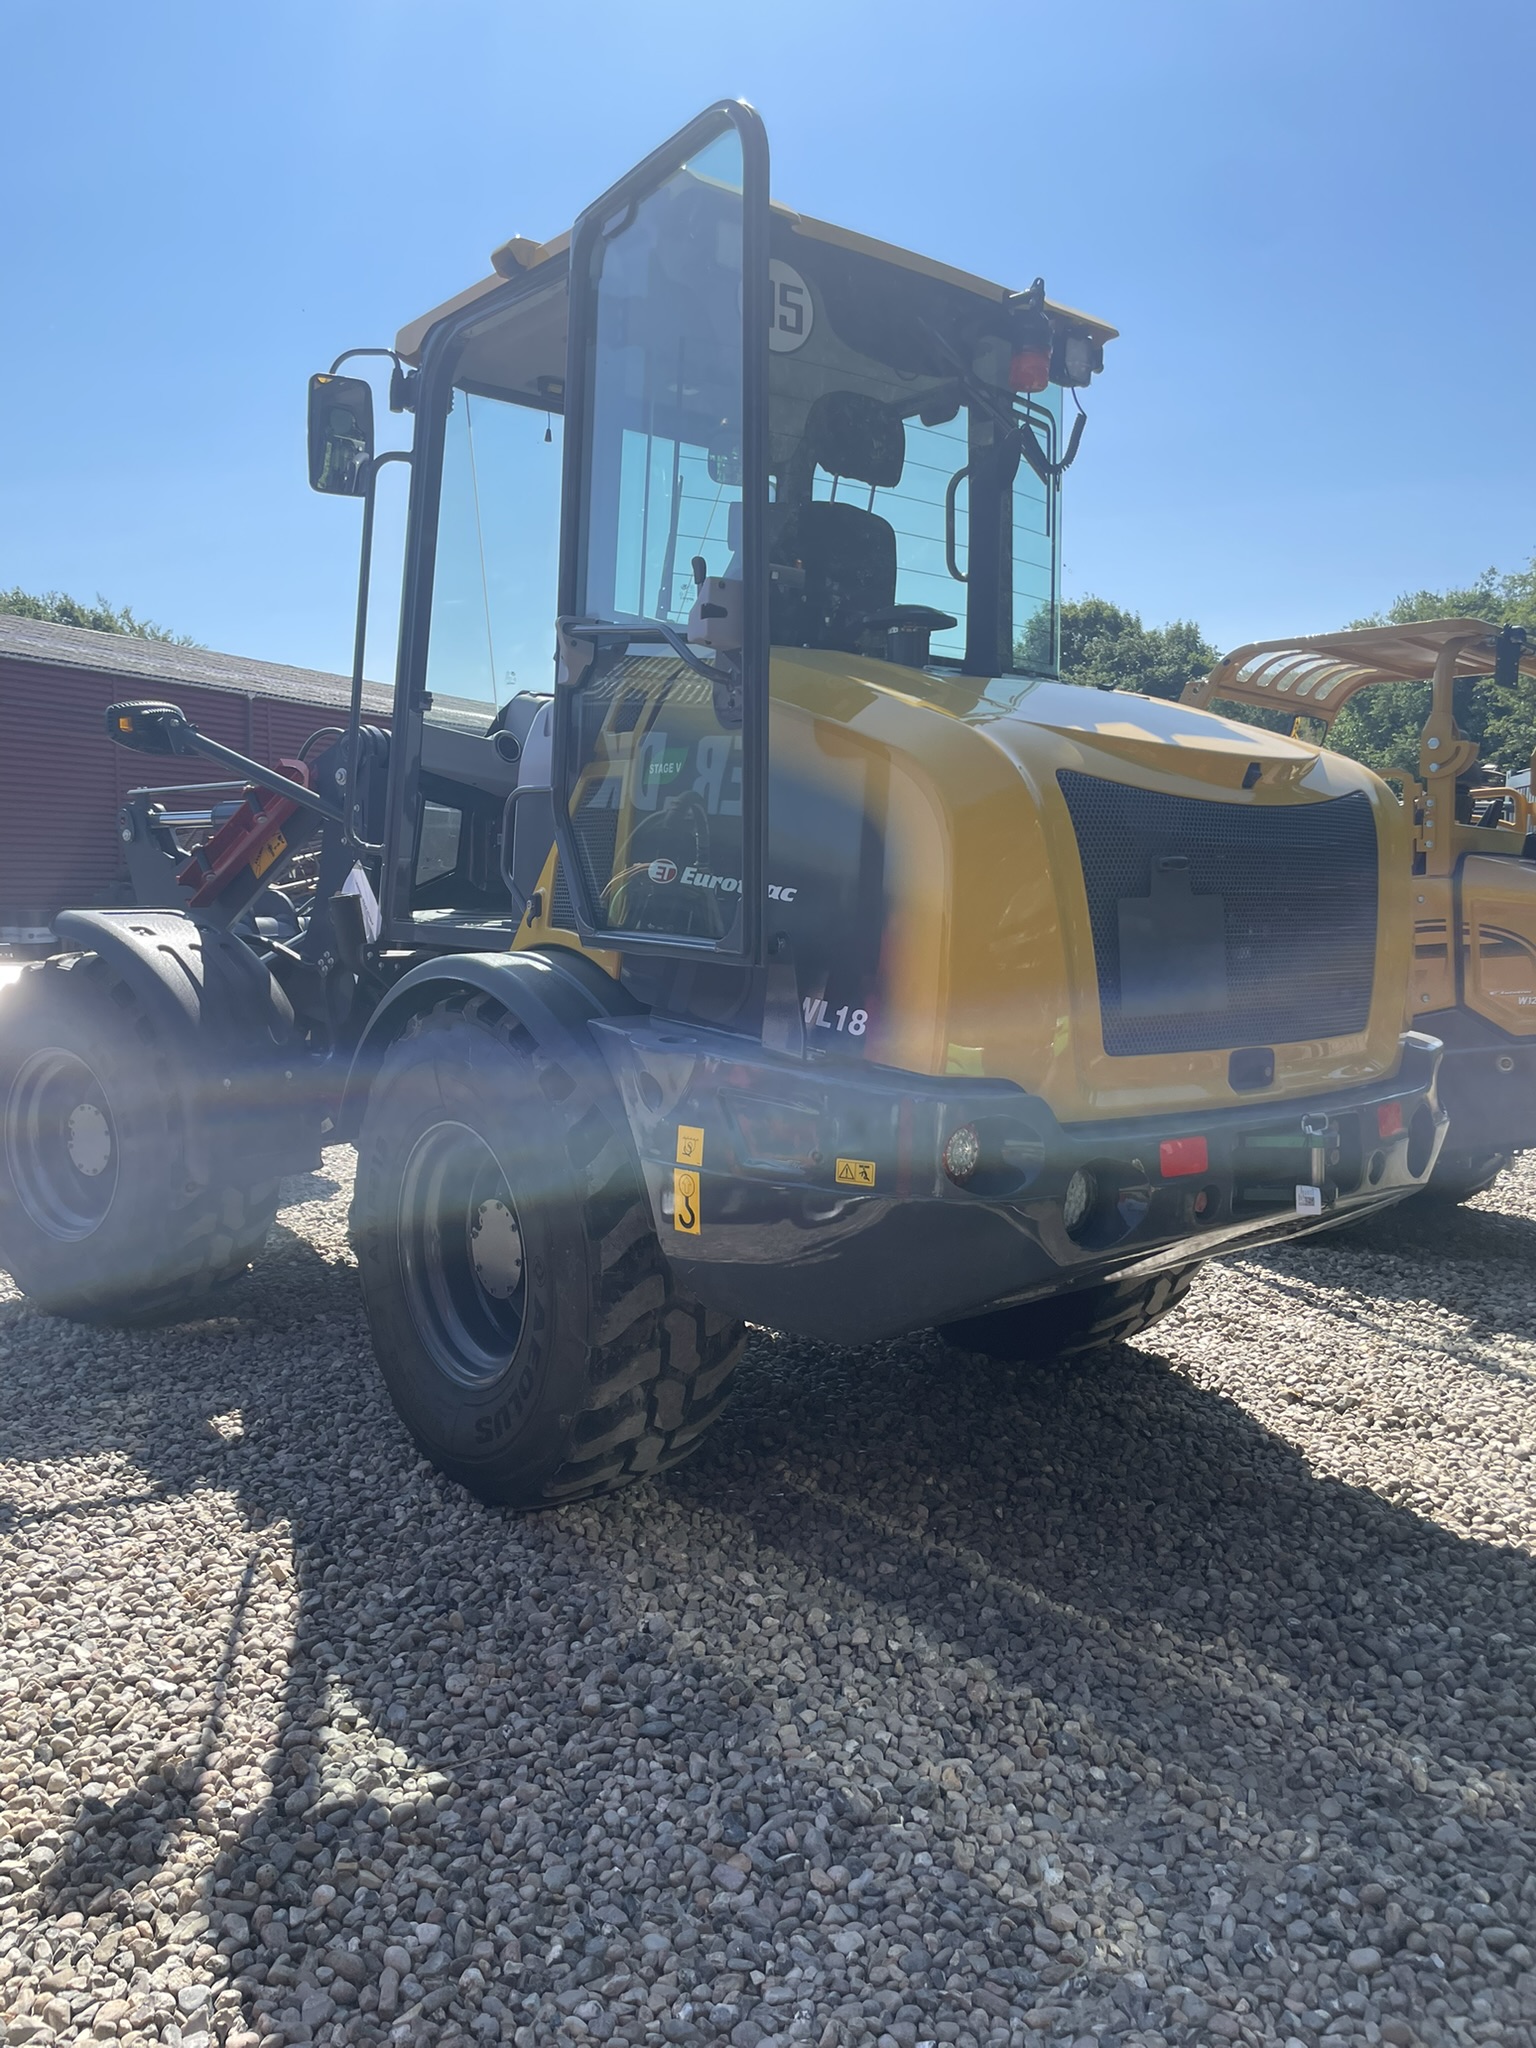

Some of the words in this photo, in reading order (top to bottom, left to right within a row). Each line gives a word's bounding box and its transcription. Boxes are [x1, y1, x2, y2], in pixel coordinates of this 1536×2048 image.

[649, 763, 674, 774] STAGE
[676, 762, 682, 773] V
[650, 860, 675, 882] ET
[680, 866, 798, 902] Eurotac
[474, 1294, 546, 1445] AEOLUS
